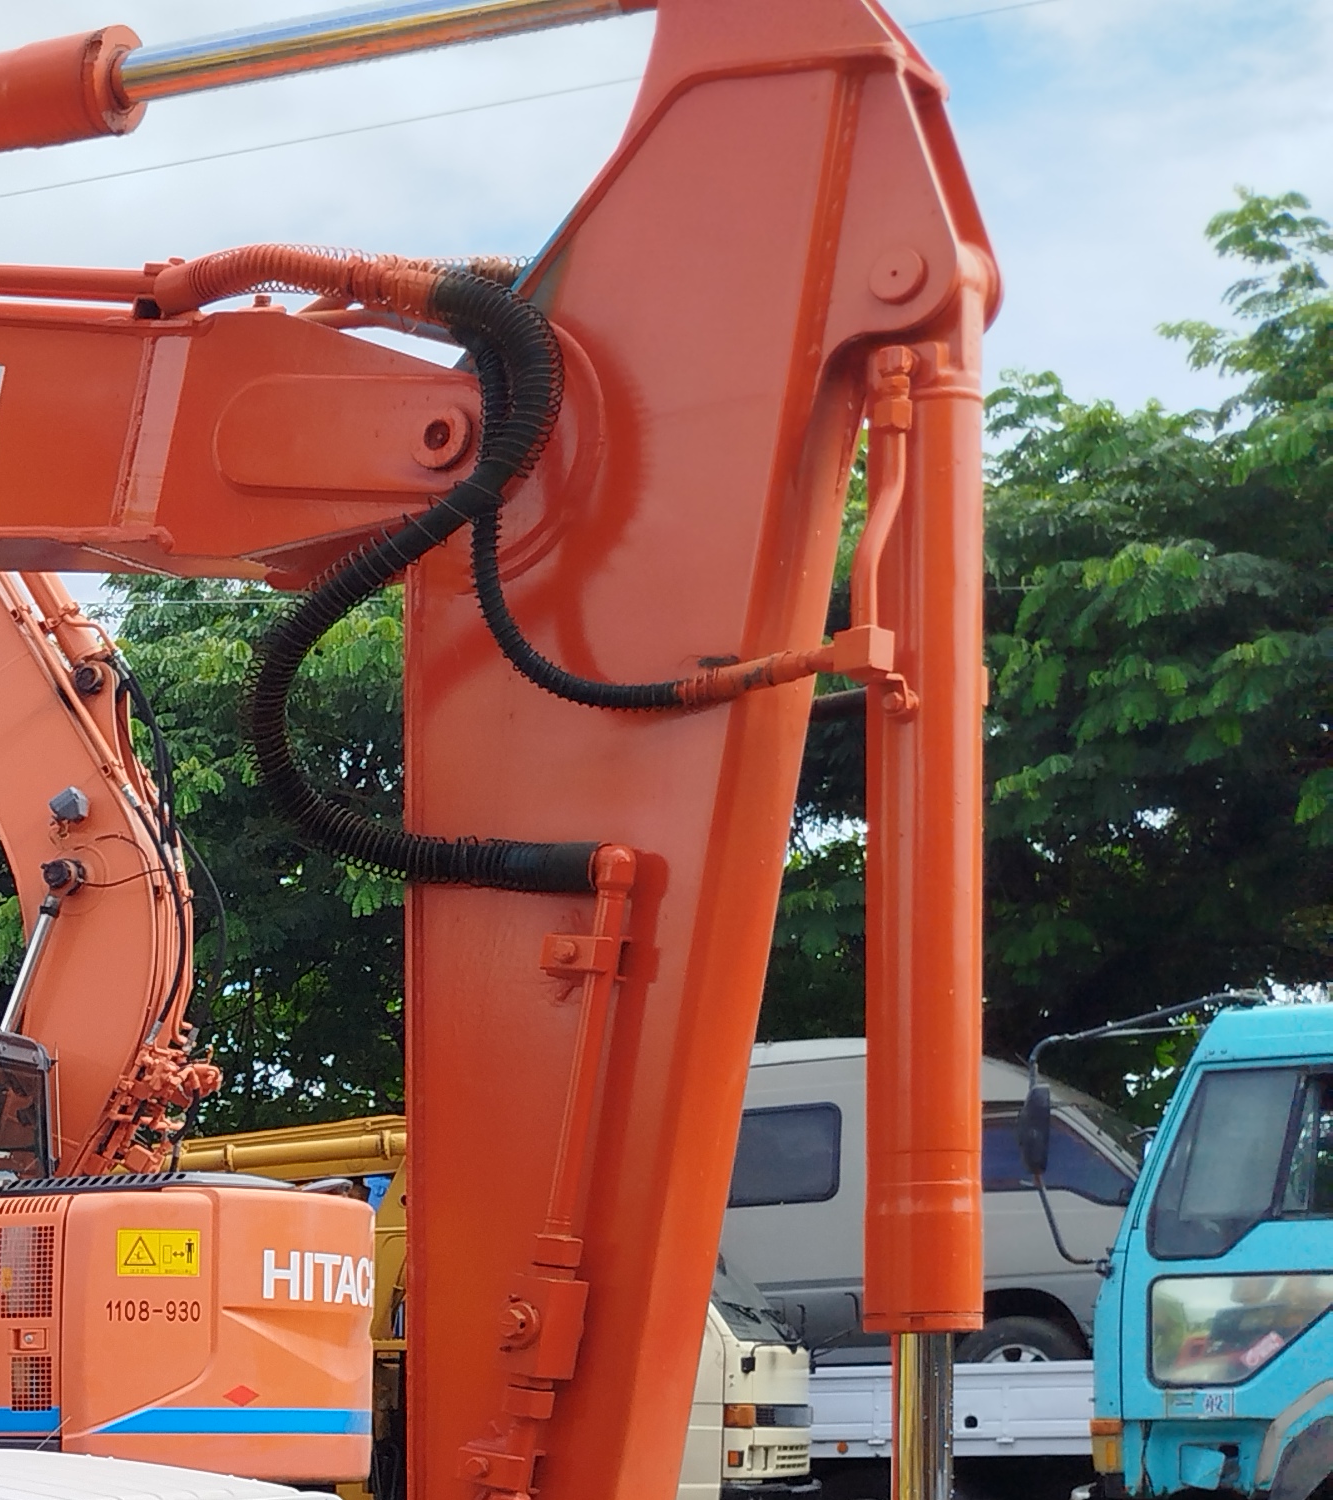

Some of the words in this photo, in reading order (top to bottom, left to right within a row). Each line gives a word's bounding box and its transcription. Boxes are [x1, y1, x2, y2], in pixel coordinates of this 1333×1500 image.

[263, 1249, 373, 1308] HITAC
[105, 1300, 201, 1322] 1108-930
[1175, 1394, 1224, 1413] 一般
